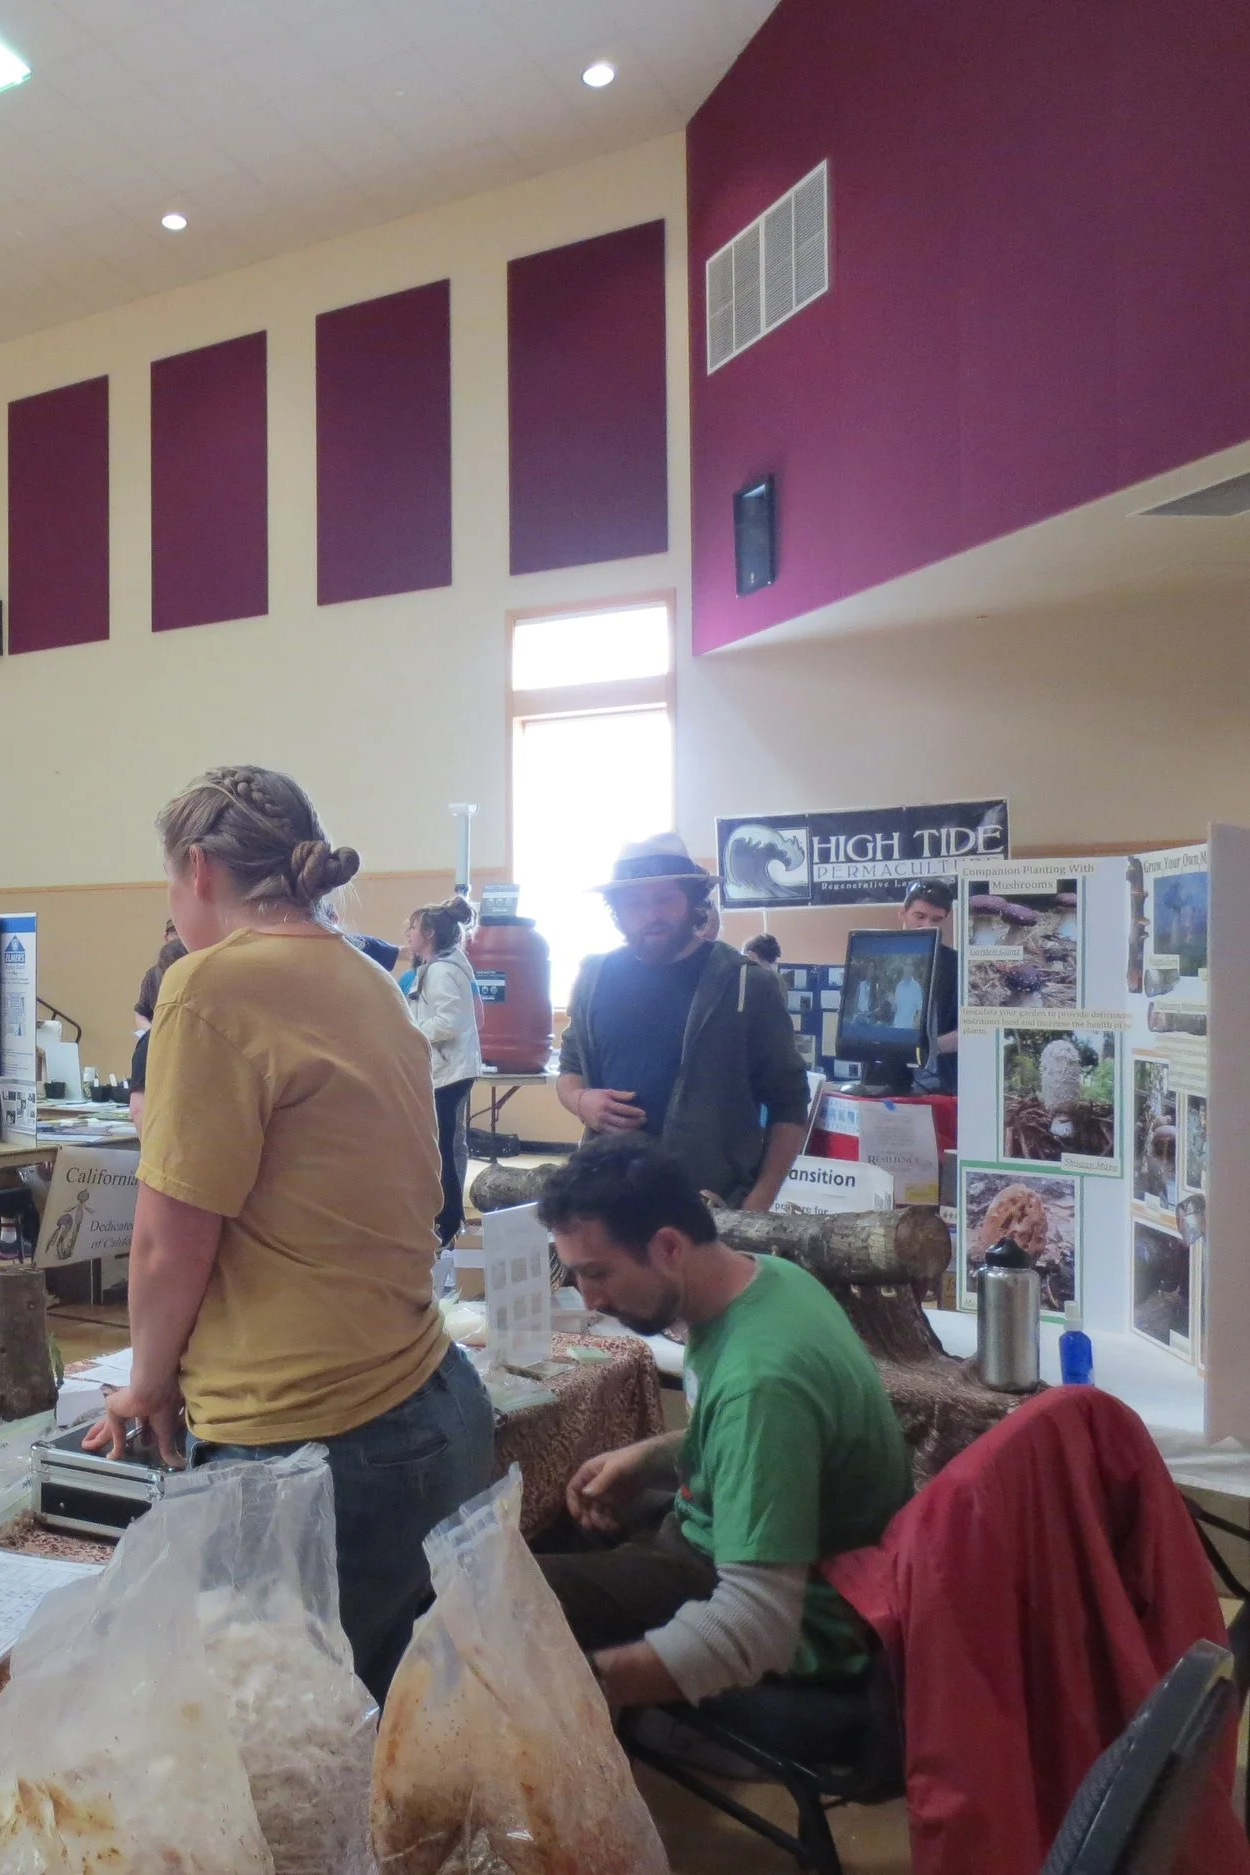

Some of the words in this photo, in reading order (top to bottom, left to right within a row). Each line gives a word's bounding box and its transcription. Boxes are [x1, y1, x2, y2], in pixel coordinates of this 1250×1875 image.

[812, 831, 901, 864] HIGH
[913, 824, 1005, 857] TIDE
[963, 866, 1020, 878] Companion
[1023, 865, 1066, 875] Planting
[1069, 864, 1094, 873] With
[1144, 857, 1161, 874] Grow
[1164, 854, 1180, 870] Your
[1183, 852, 1199, 867] Own
[821, 880, 889, 890] Regenerative
[993, 880, 1053, 890] Mushrooms
[66, 1167, 138, 1186] California
[788, 1167, 856, 1187] ansition
